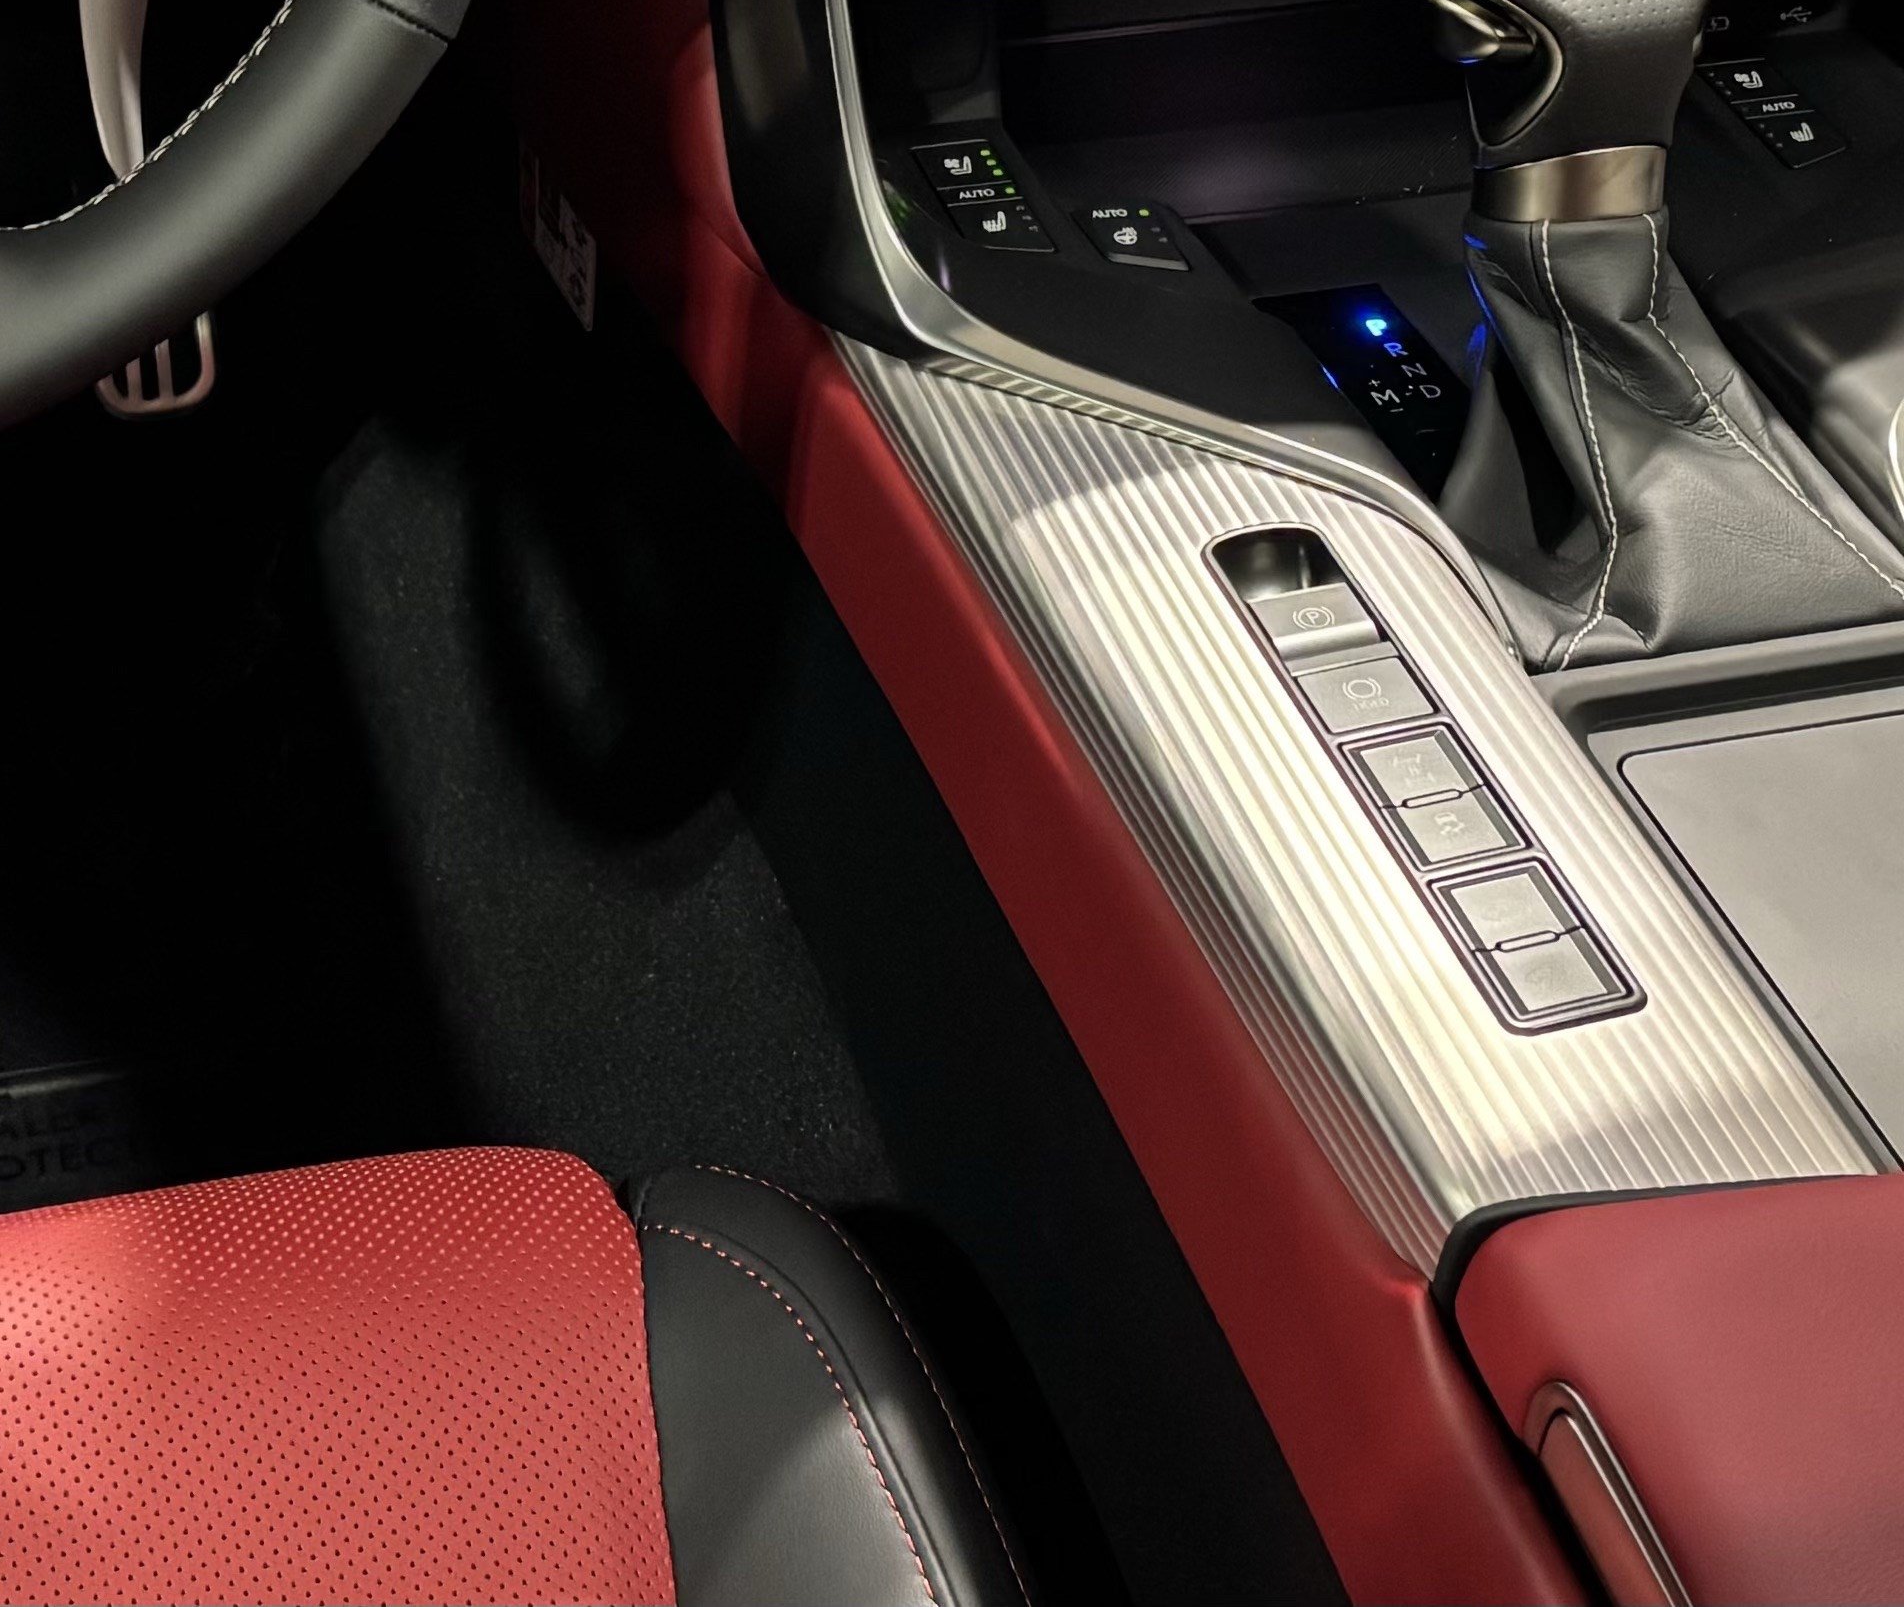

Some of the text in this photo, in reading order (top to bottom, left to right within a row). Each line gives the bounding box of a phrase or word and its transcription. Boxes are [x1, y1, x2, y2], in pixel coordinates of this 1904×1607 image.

[1762, 100, 1795, 112] AUTO
[959, 188, 996, 200] AUTO
[1092, 208, 1128, 218] AUTO
[1371, 389, 1400, 405] M
[1419, 385, 1441, 398] D
